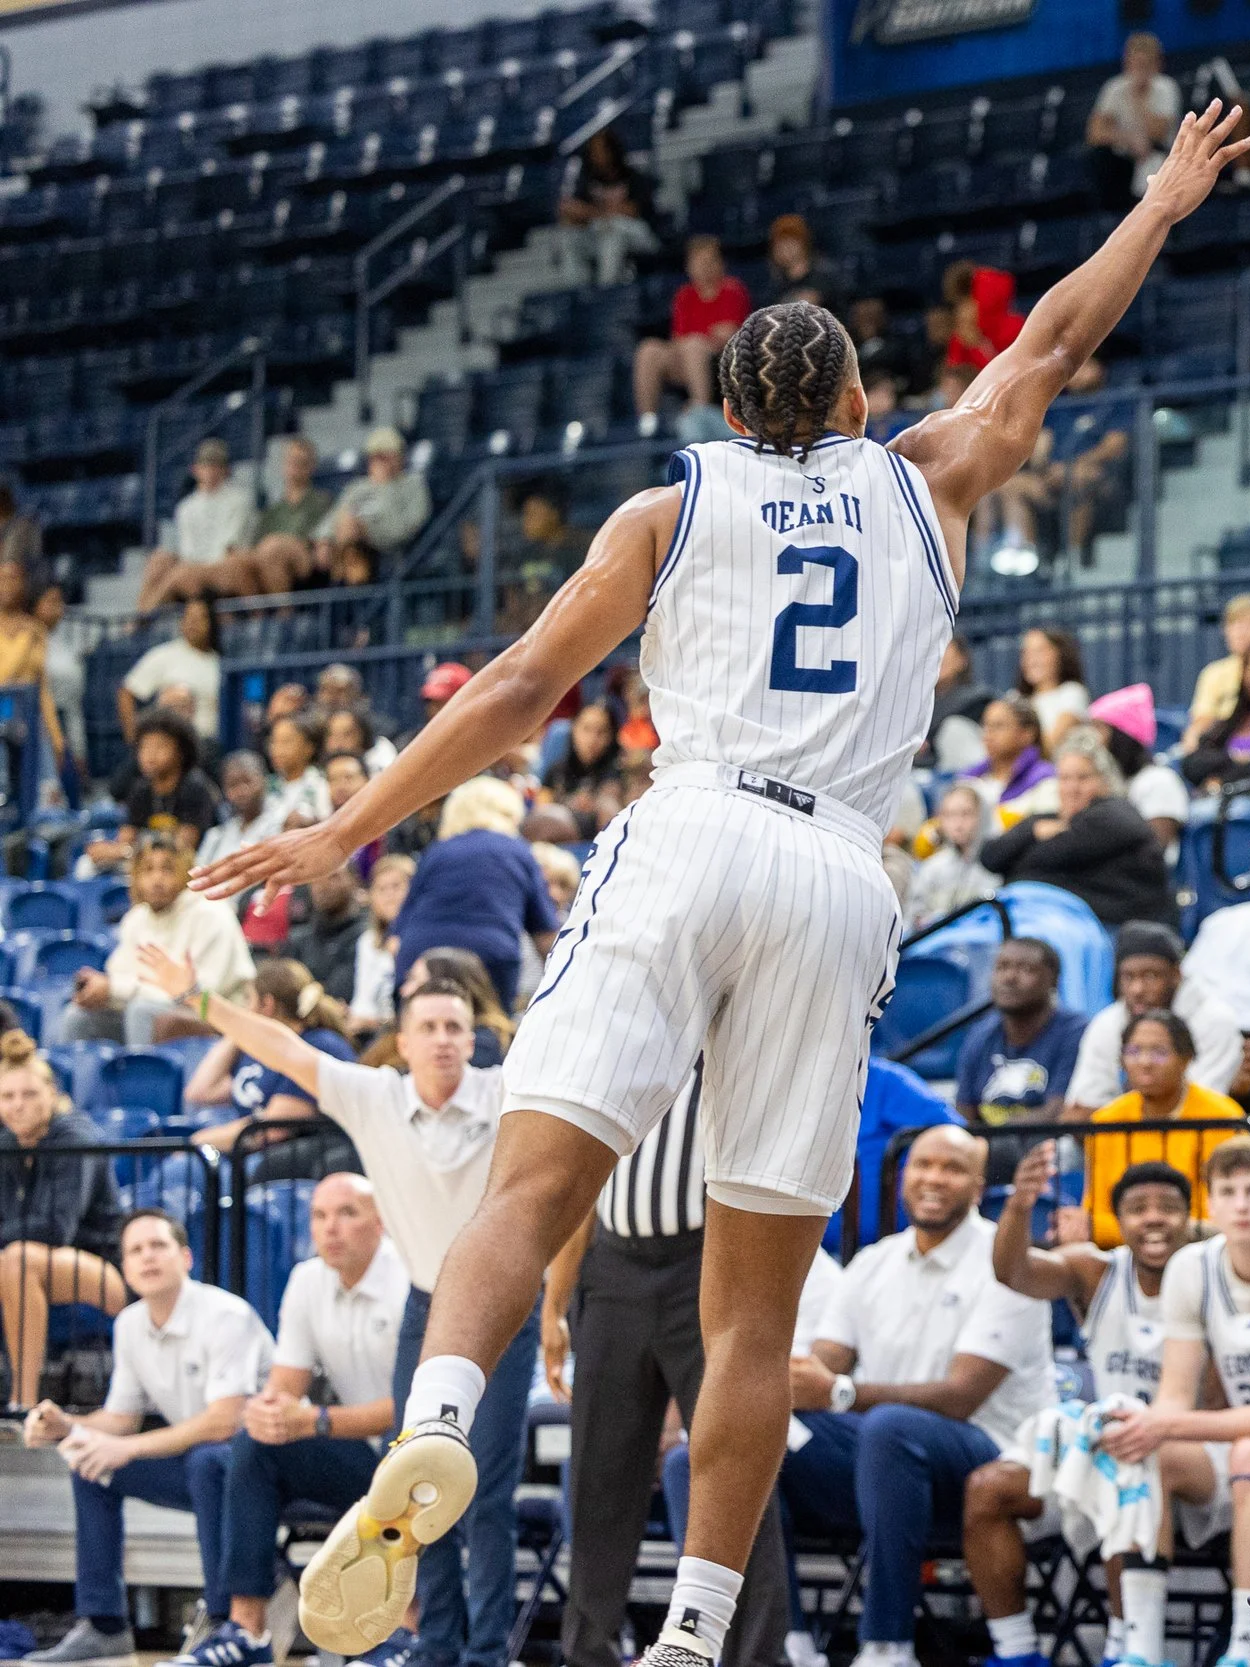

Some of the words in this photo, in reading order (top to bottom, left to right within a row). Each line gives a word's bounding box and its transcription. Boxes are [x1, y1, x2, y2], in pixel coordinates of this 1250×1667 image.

[761, 499, 834, 534] DEAN
[840, 493, 863, 534] II
[769, 544, 859, 694] 2
